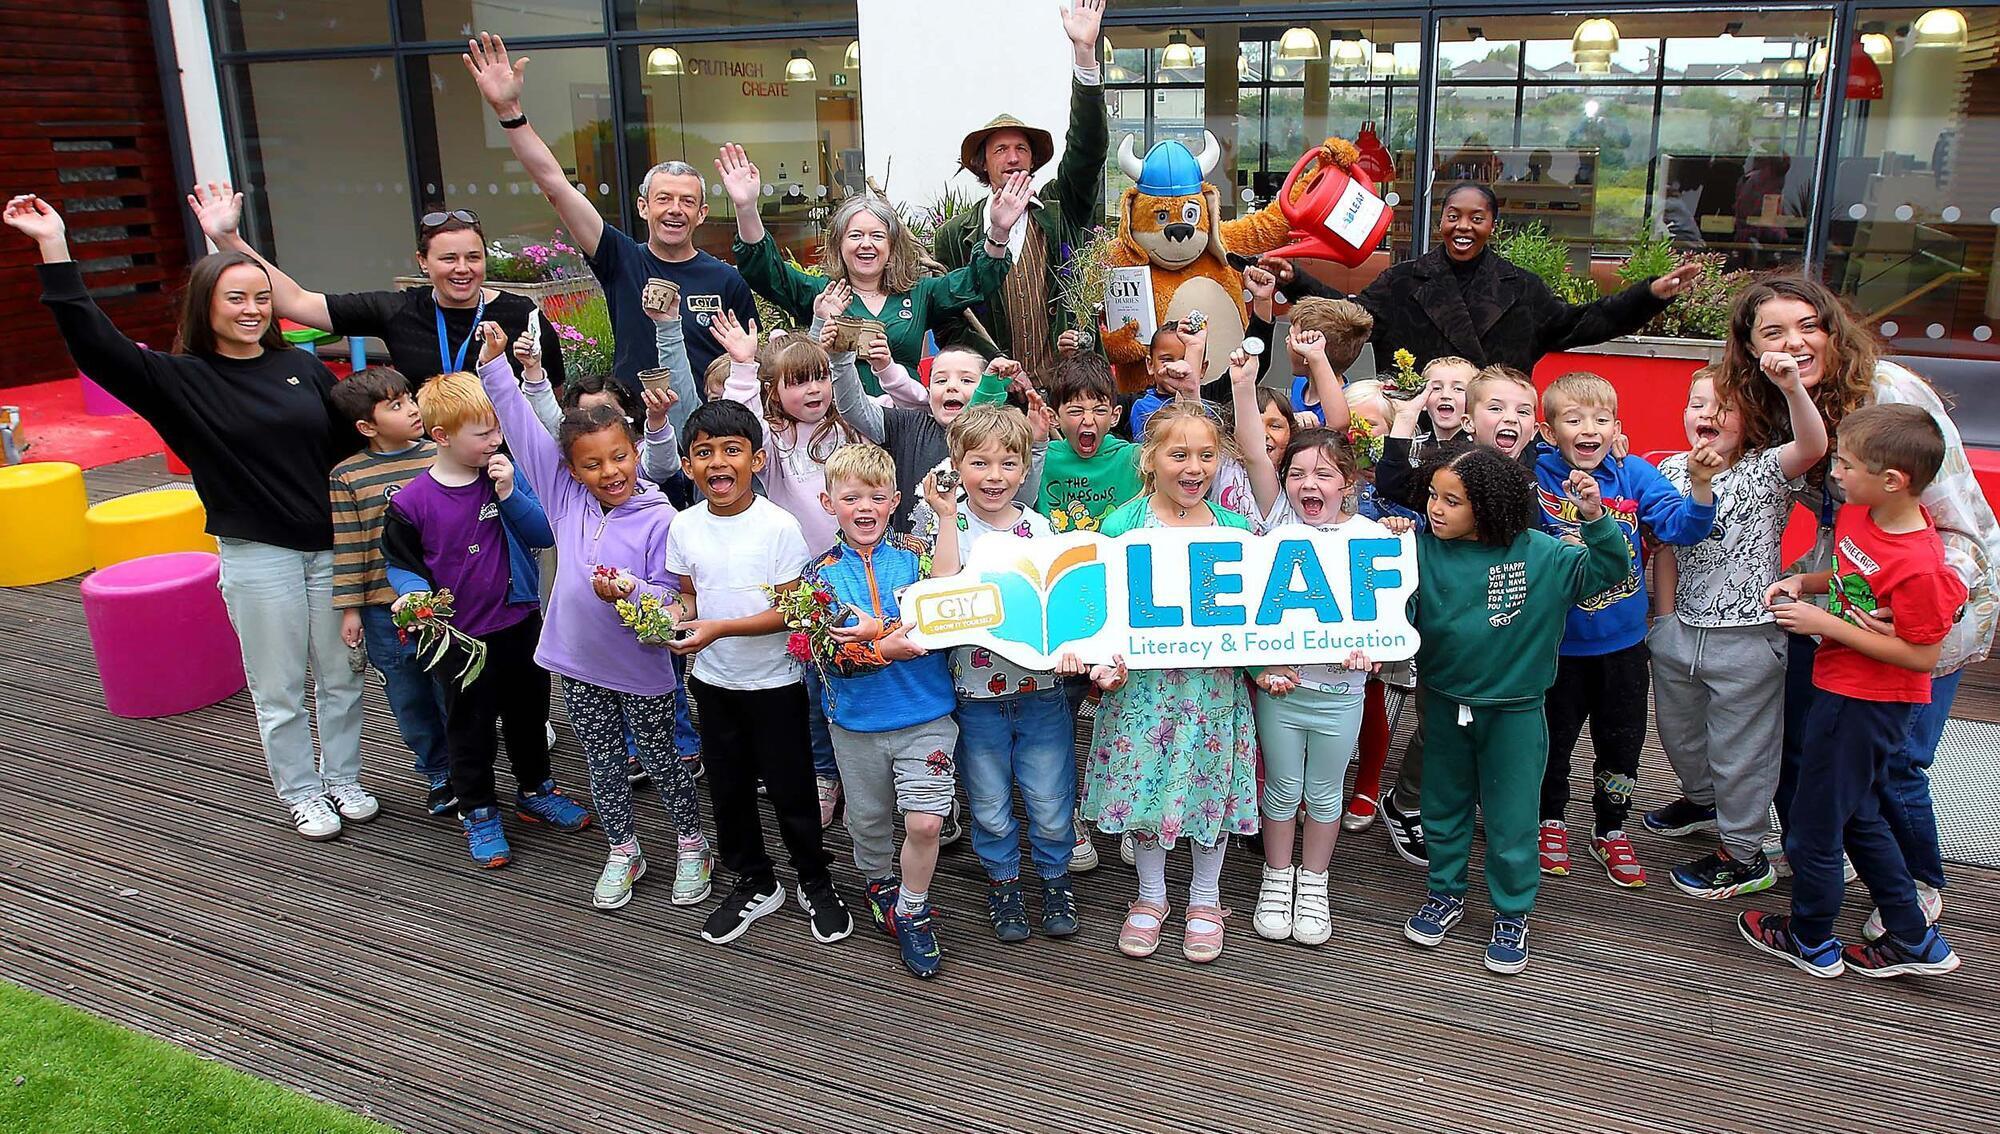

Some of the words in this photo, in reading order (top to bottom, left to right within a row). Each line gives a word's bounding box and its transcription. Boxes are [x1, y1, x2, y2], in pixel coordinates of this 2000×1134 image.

[742, 81, 790, 97] CREATE
[1349, 192, 1365, 214] LEAF
[1109, 281, 1141, 297] GIY
[695, 297, 713, 308] GIY
[1488, 573, 1506, 581] WITH
[1508, 571, 1526, 579] WHAT
[1489, 566, 1502, 574] BE
[1503, 562, 1525, 572] HAPPY
[1126, 538, 1402, 628] LEAF
[1508, 577, 1526, 586] HAVE
[937, 592, 977, 619] GIY
[1505, 600, 1525, 608] WANT
[1129, 635, 1213, 660] Literacy
[1221, 633, 1236, 651] &
[1245, 631, 1295, 651] Food
[1304, 629, 1406, 649] Education
